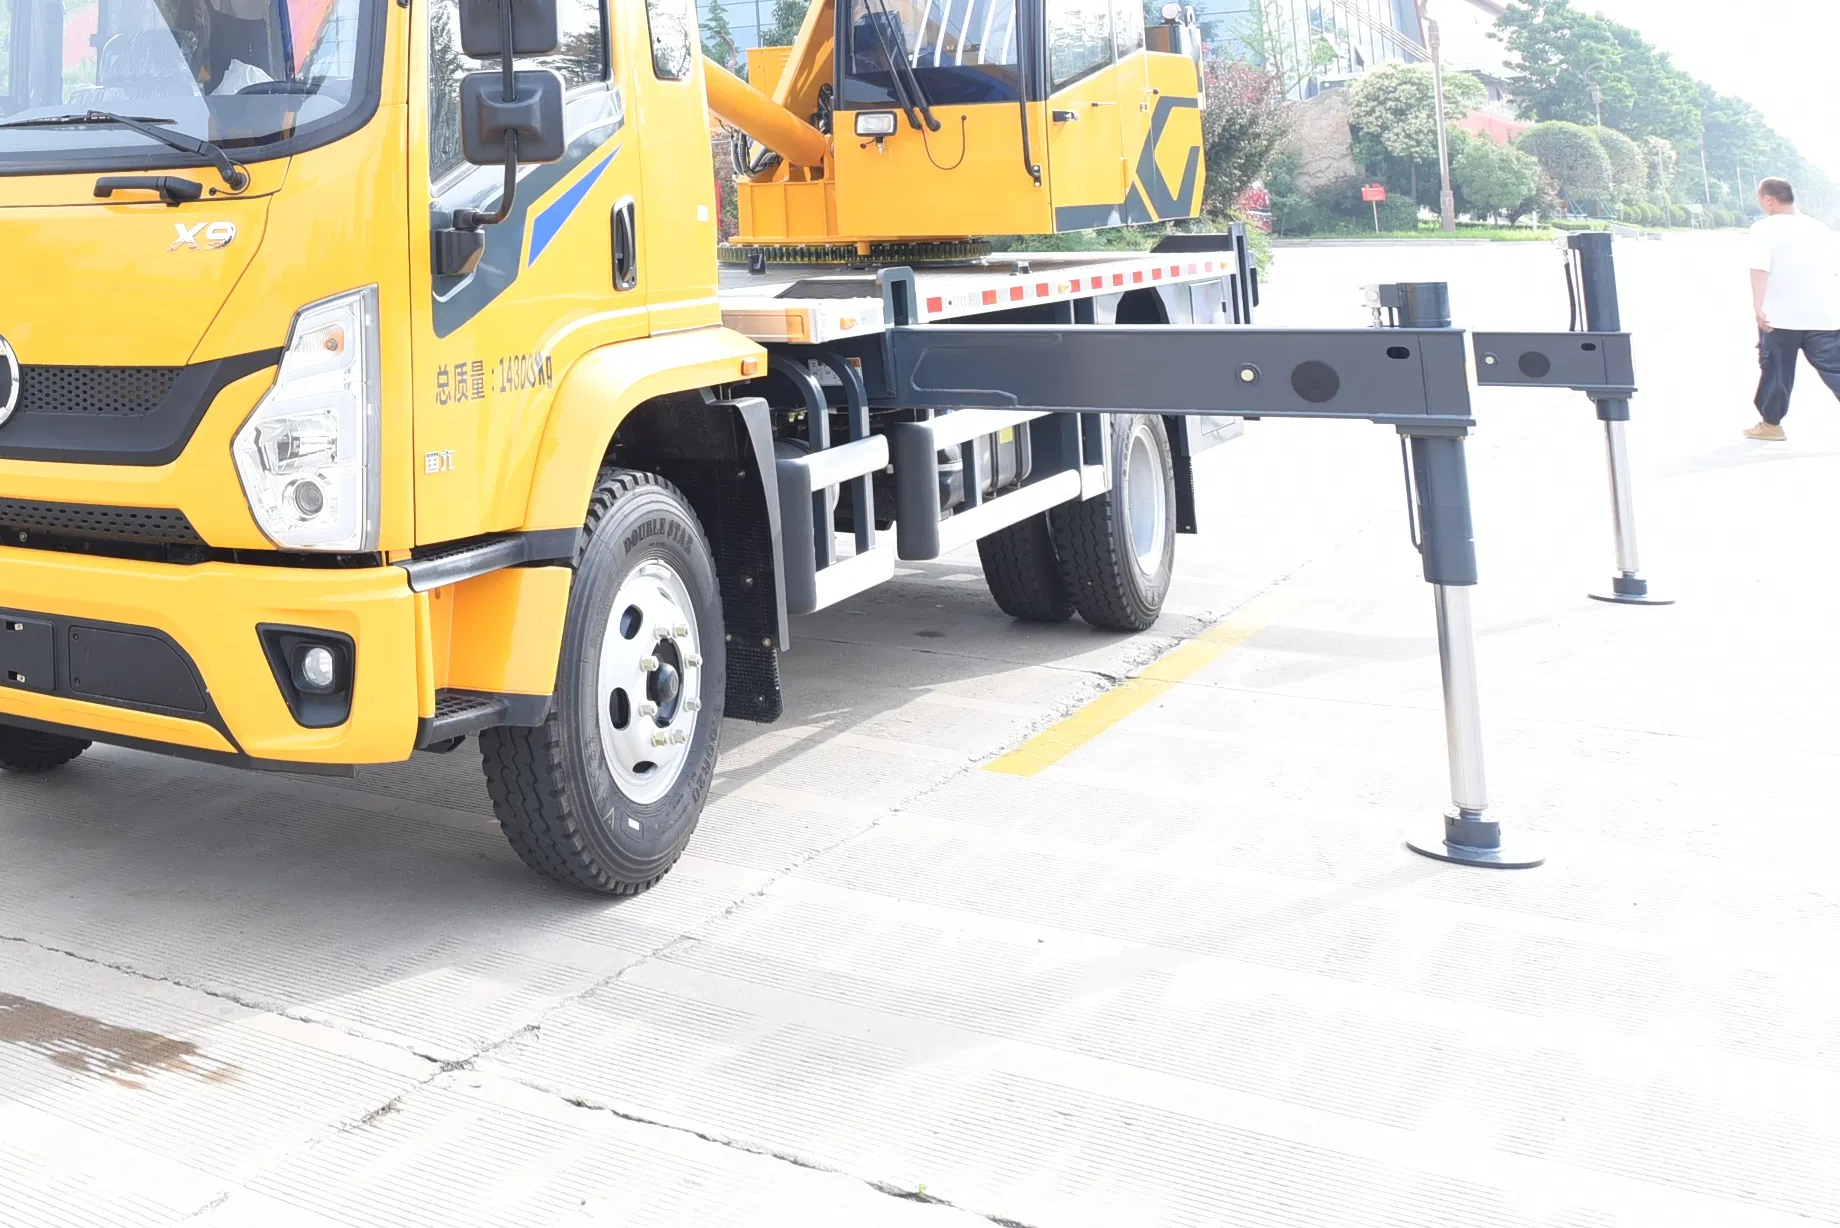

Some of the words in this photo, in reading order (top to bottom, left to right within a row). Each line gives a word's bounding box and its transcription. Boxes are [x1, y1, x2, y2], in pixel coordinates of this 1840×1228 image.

[166, 221, 237, 252] X9
[622, 517, 666, 558] DOUBLE
[666, 519, 694, 557] STAR
